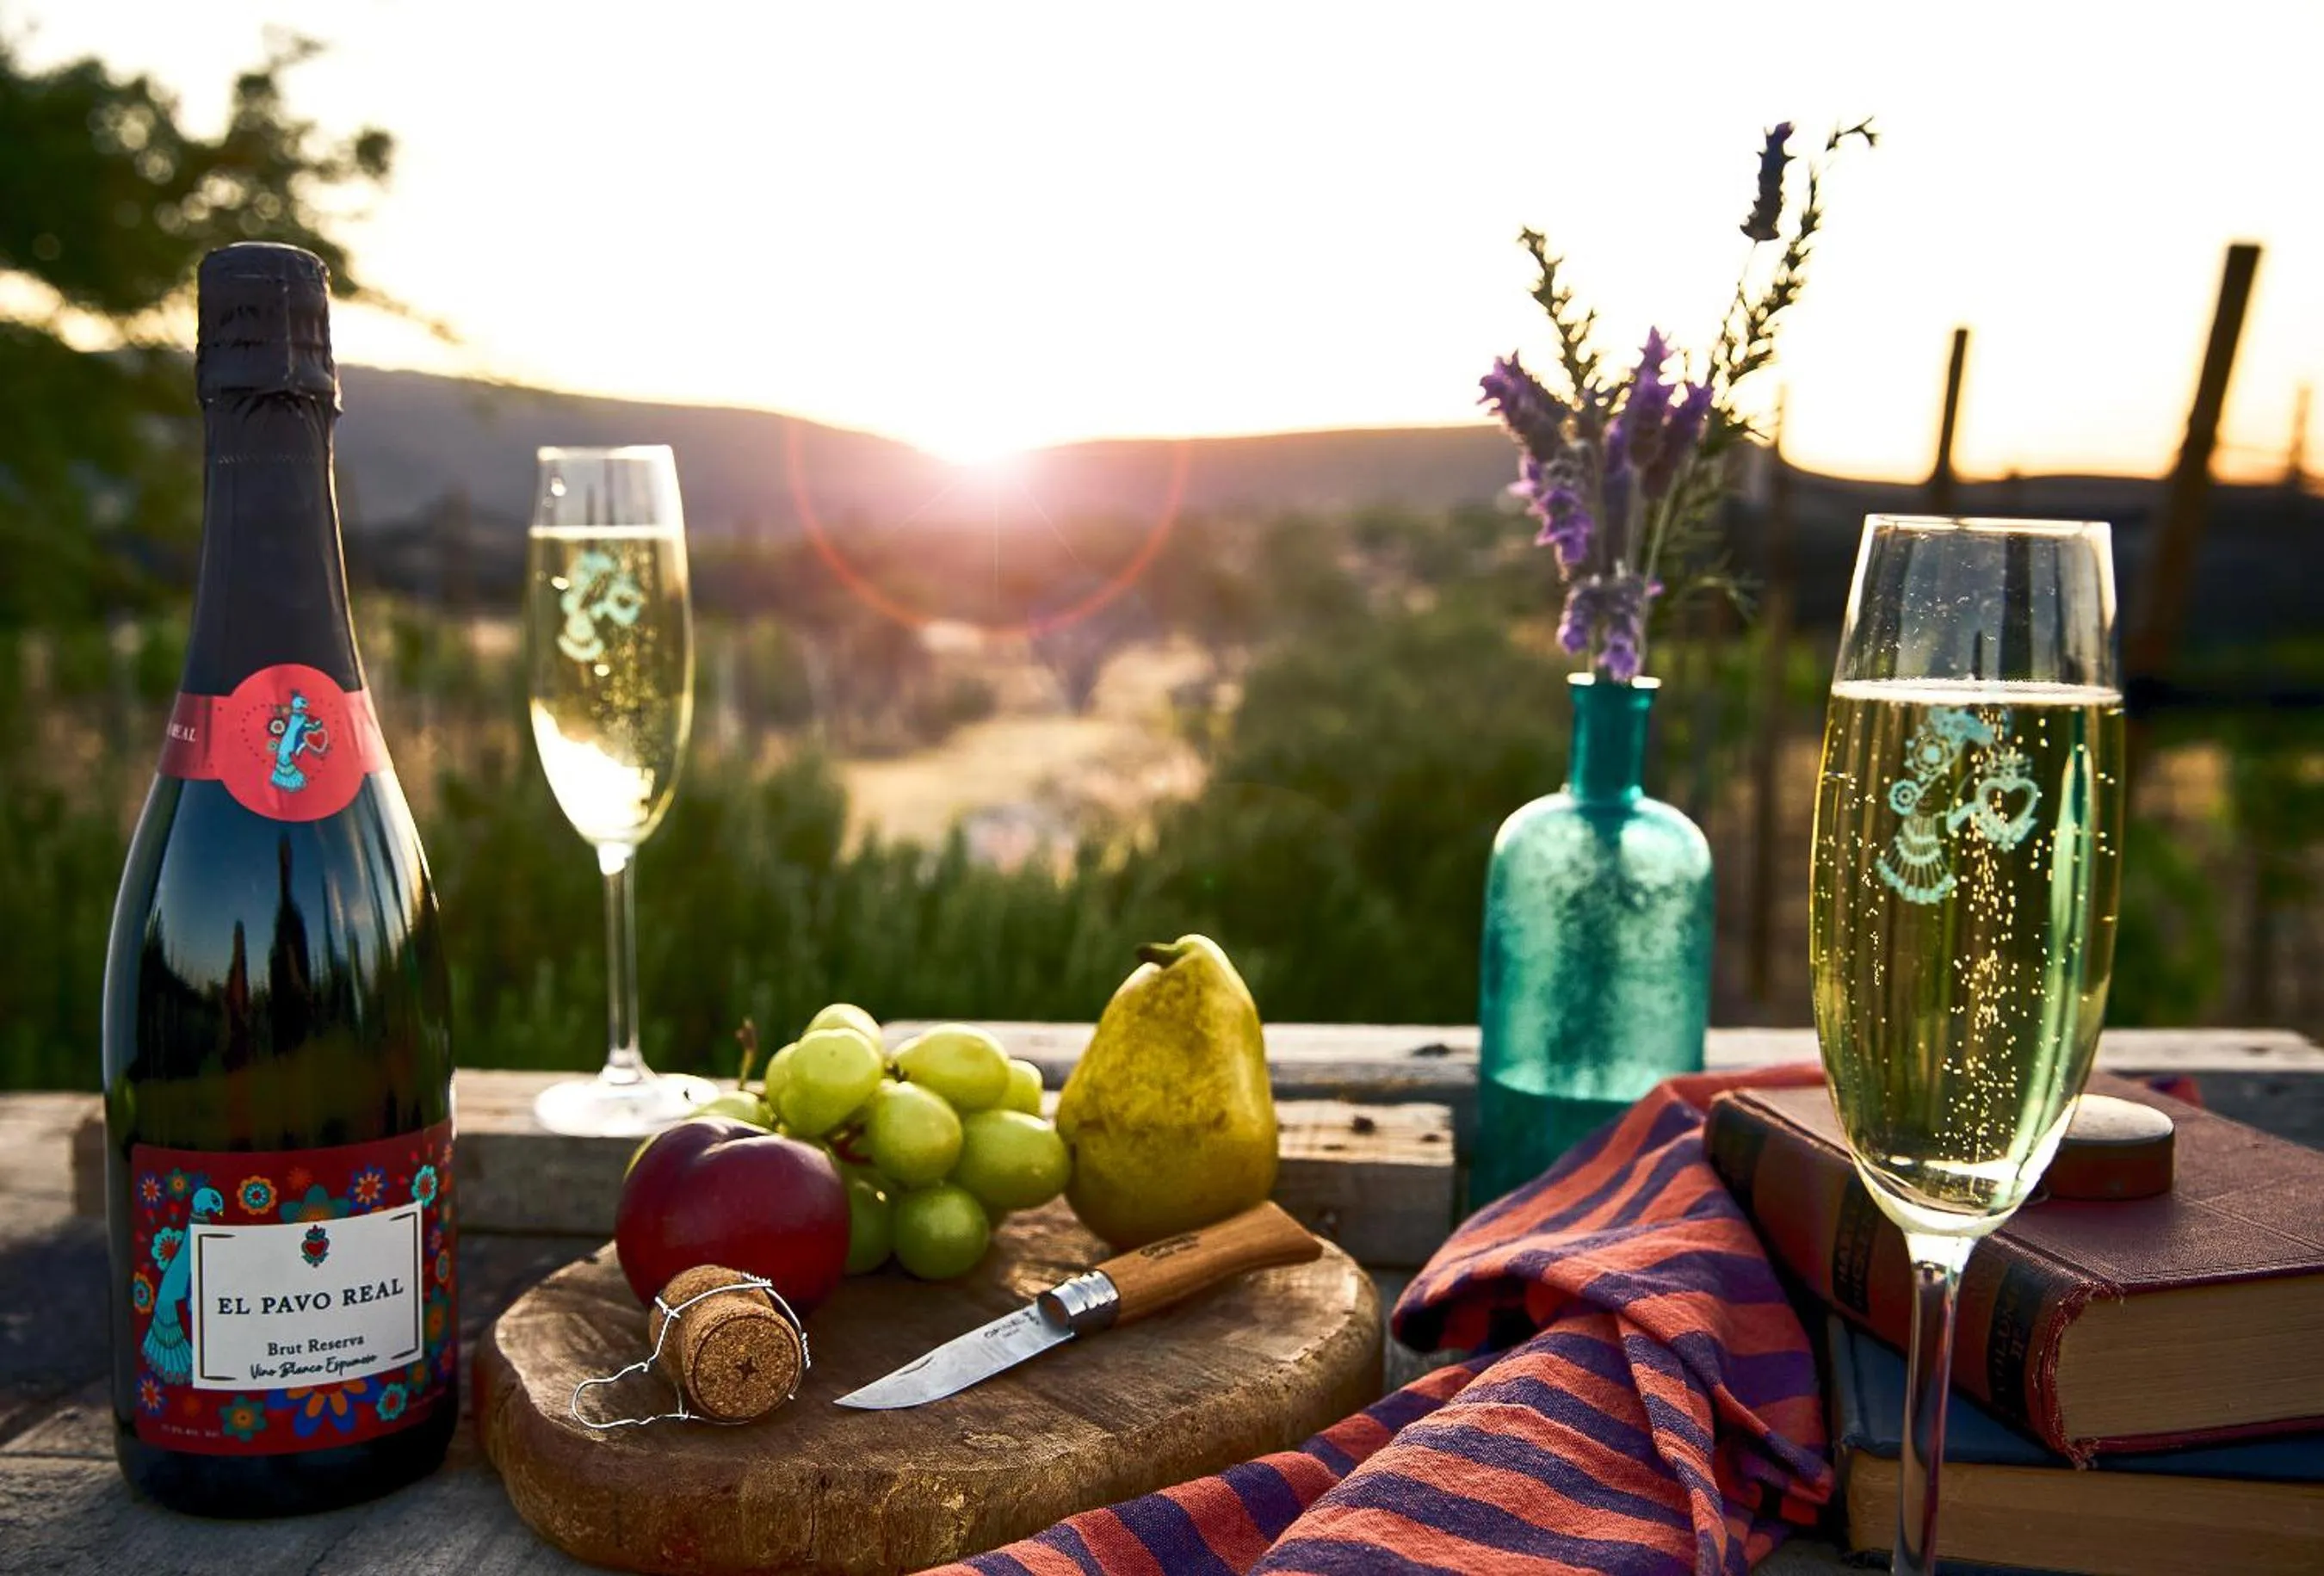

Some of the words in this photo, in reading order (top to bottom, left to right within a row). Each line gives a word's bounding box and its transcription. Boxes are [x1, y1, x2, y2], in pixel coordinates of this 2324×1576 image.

[218, 1297, 250, 1314] EL
[262, 1292, 331, 1314] PAVO
[343, 1278, 404, 1307] REAL
[268, 1342, 302, 1356] Brut
[308, 1335, 364, 1353] Reserva
[250, 1363, 276, 1380] Vino
[279, 1361, 323, 1378] Blanco
[325, 1354, 377, 1375] Espumoso
